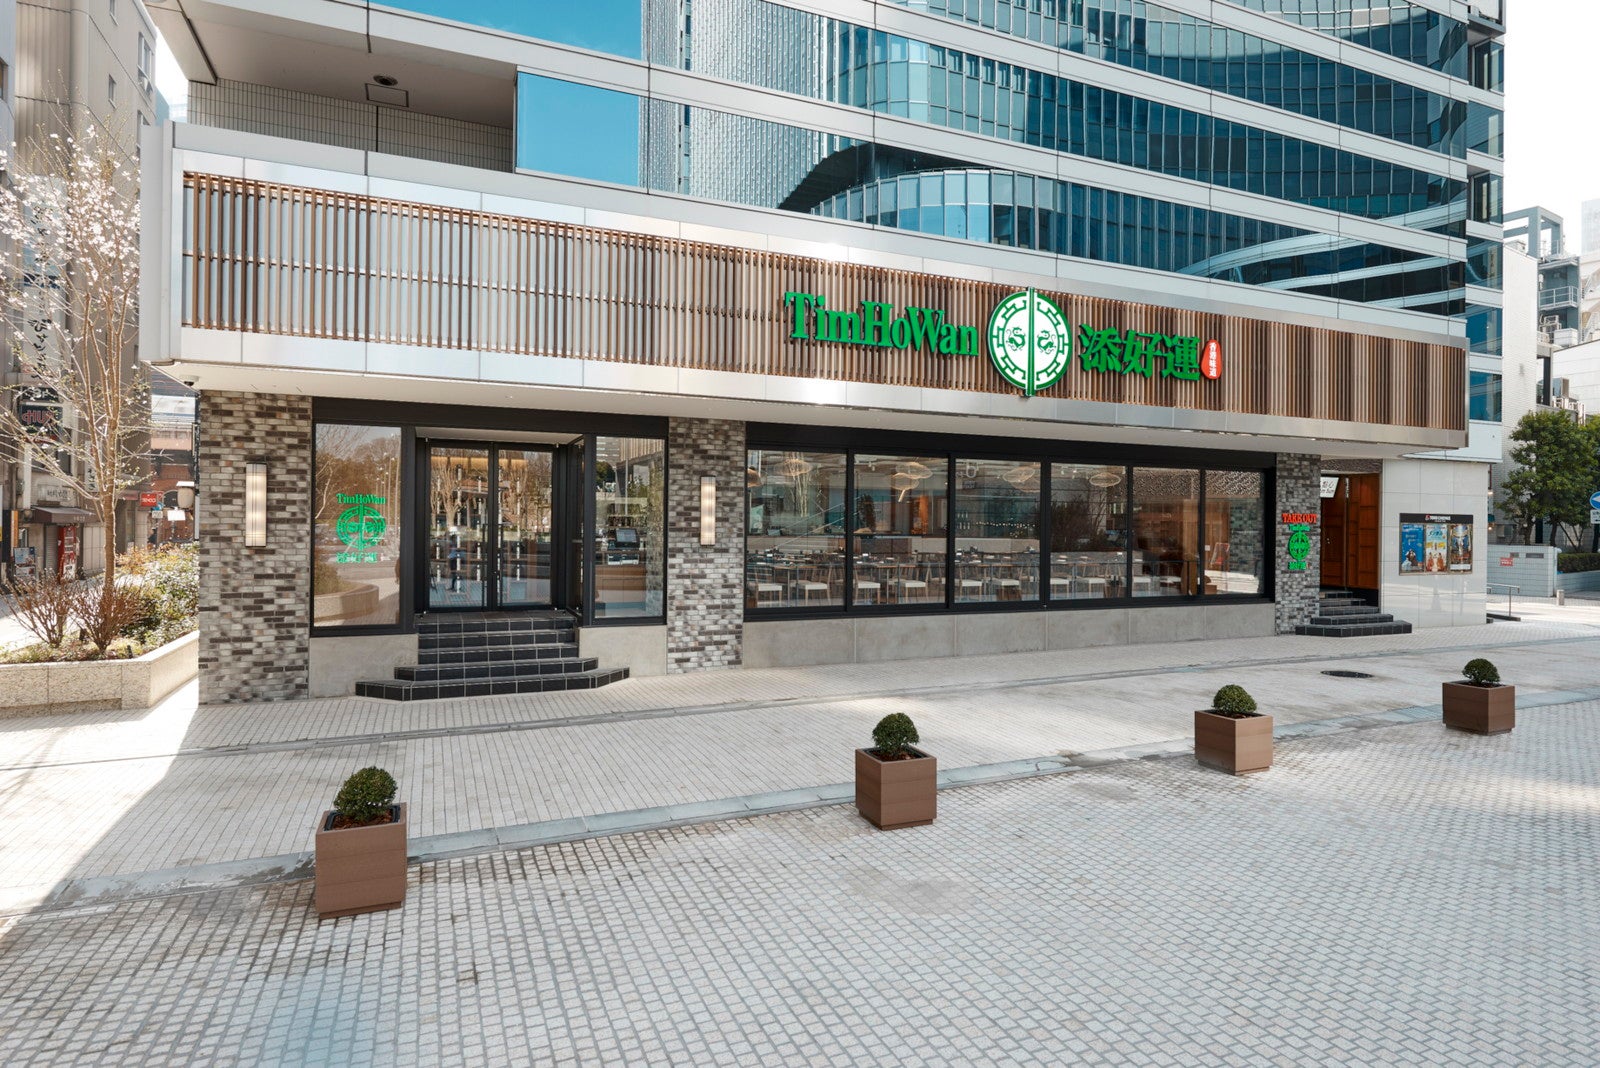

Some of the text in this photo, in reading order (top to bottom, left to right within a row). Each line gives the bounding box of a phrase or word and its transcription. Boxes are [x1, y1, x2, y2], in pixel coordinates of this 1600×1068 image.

[784, 291, 980, 357] TimHoWan
[1077, 323, 1201, 381] 添好運
